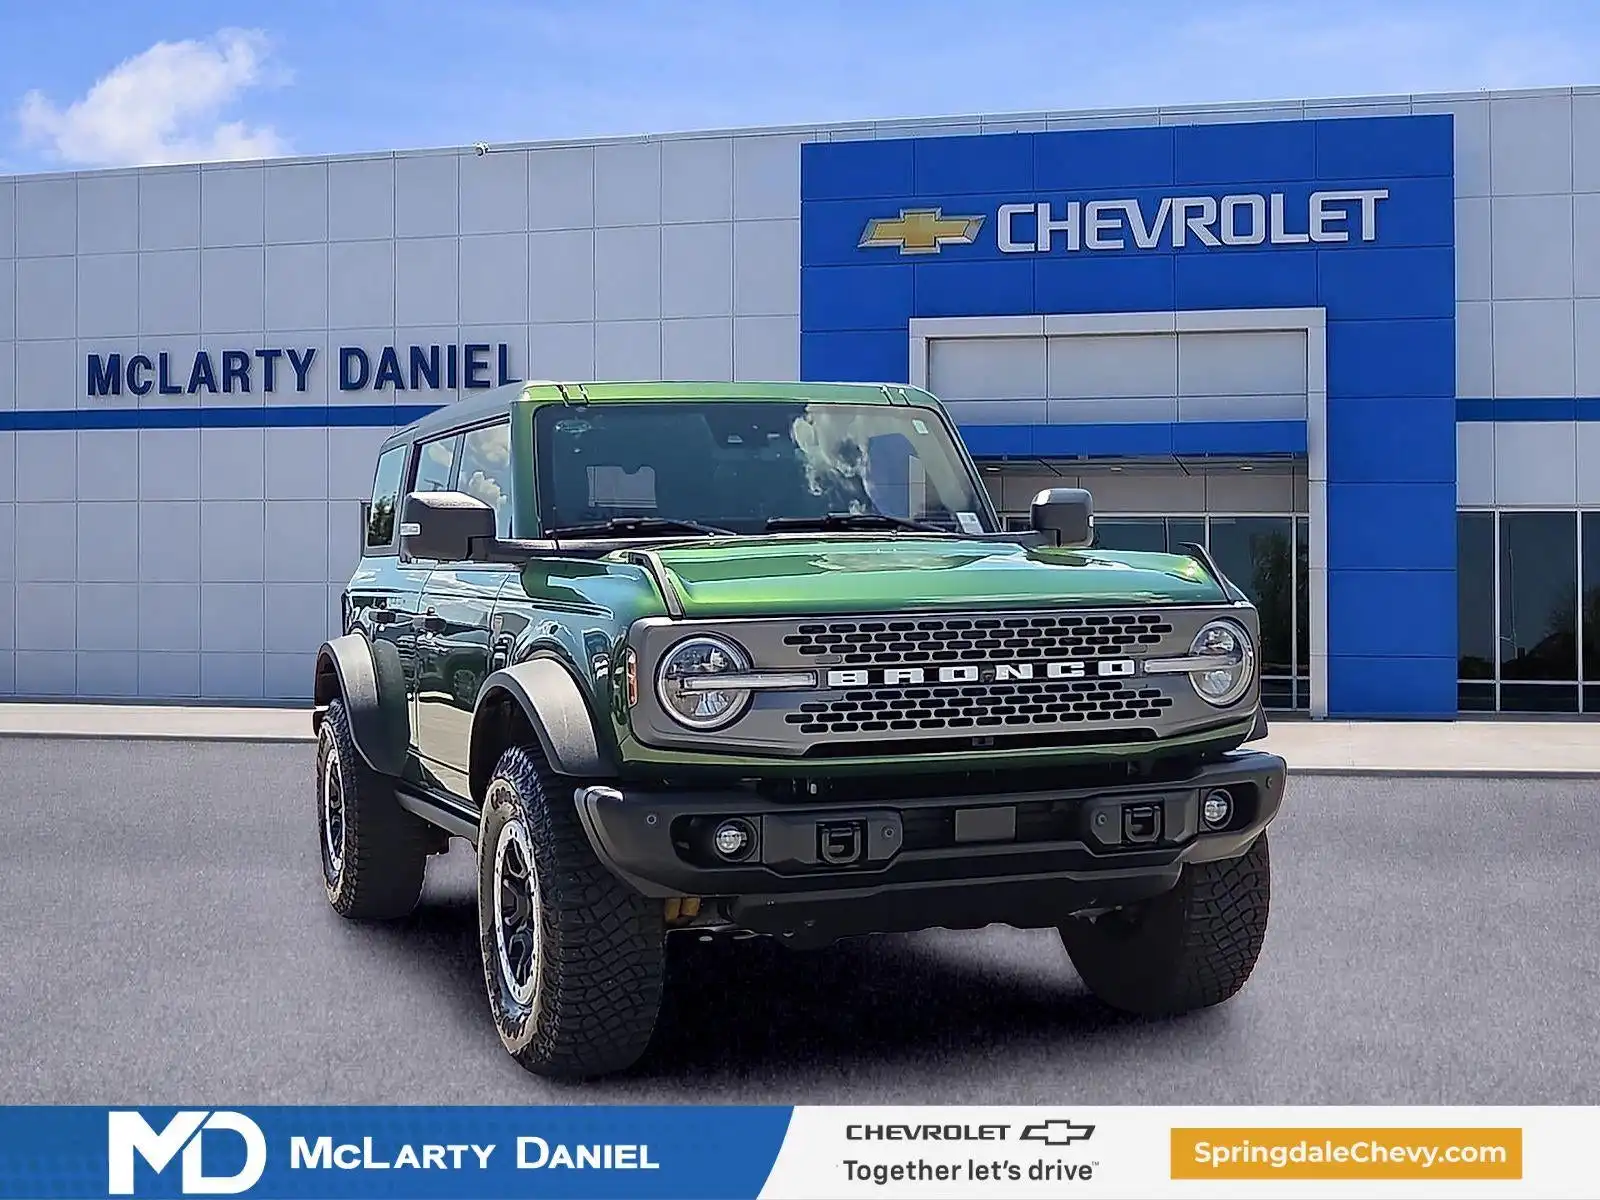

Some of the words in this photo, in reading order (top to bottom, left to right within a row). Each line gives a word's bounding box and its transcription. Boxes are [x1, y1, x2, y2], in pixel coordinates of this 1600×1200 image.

[997, 189, 1389, 253] CHEVROLET
[339, 343, 523, 391] DANIEL
[827, 659, 1135, 686] BRONCO
